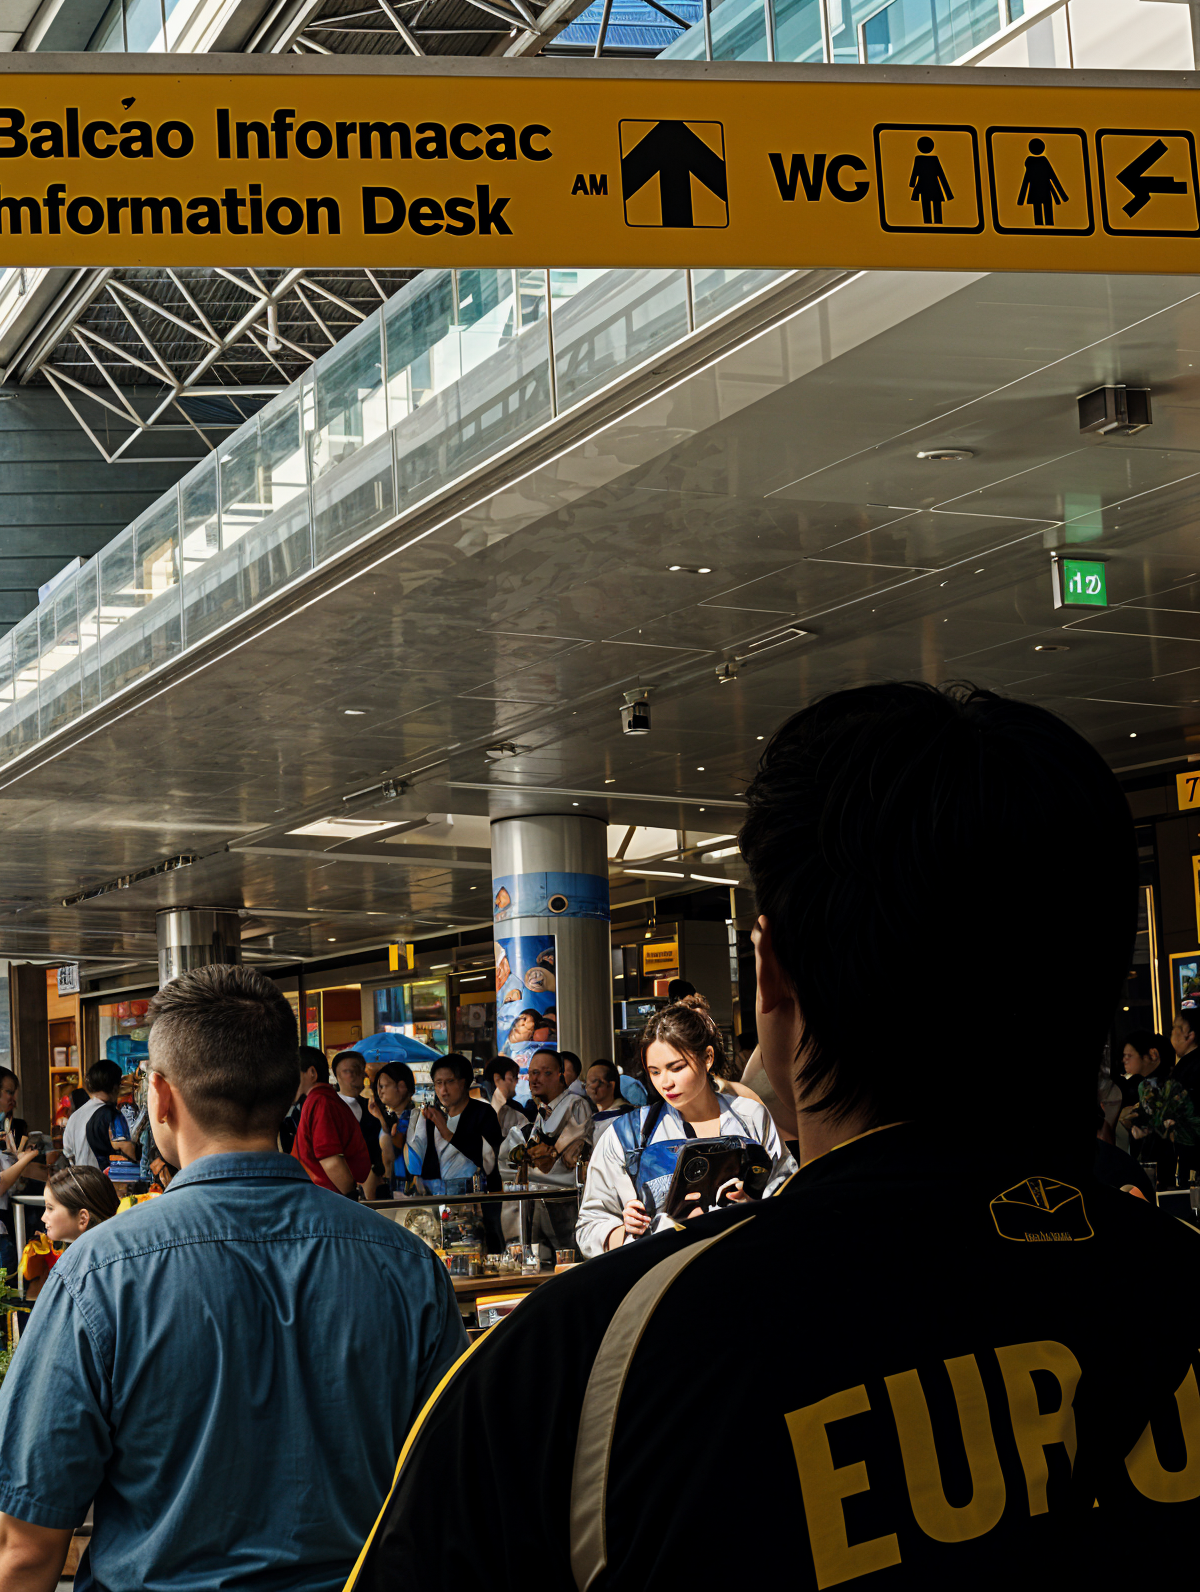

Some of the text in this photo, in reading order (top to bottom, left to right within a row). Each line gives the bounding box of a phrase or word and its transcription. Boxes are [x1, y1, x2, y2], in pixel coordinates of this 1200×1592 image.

[216, 108, 553, 162] Informacac
[570, 173, 609, 196] AM
[768, 152, 870, 203] WC
[361, 184, 514, 236] Desk
